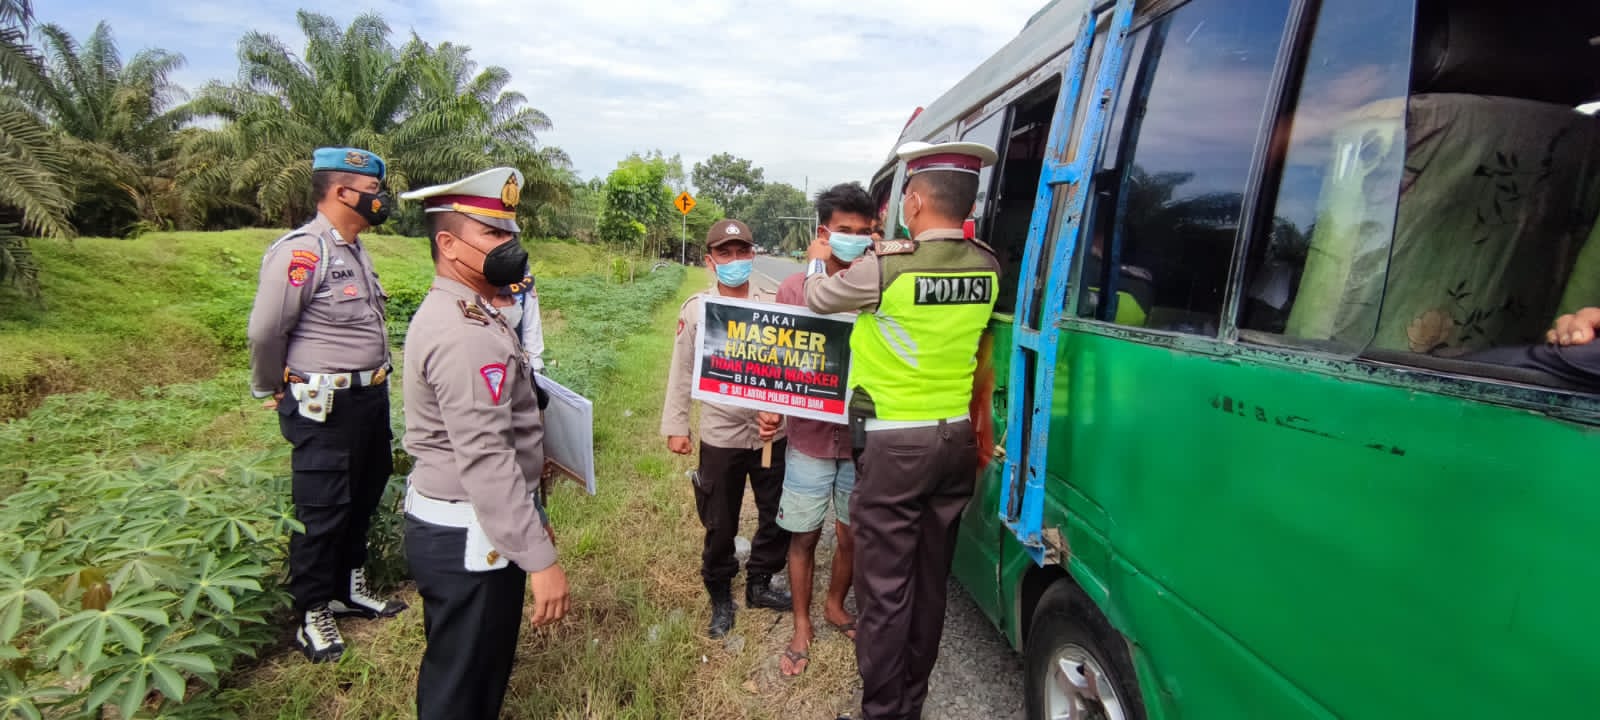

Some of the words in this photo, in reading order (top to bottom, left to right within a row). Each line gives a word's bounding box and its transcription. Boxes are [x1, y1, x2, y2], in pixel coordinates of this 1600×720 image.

[916, 277, 991, 303] POLISI
[752, 312, 796, 327] PAKAI
[727, 320, 826, 352] MASKER
[724, 341, 779, 365] HARGA
[783, 350, 826, 372] MATI
[710, 355, 743, 373] TIDAK
[745, 361, 783, 379] PAKAI
[784, 368, 839, 388] MASKER
[734, 374, 767, 388] BISA
[774, 381, 808, 394] MATI
